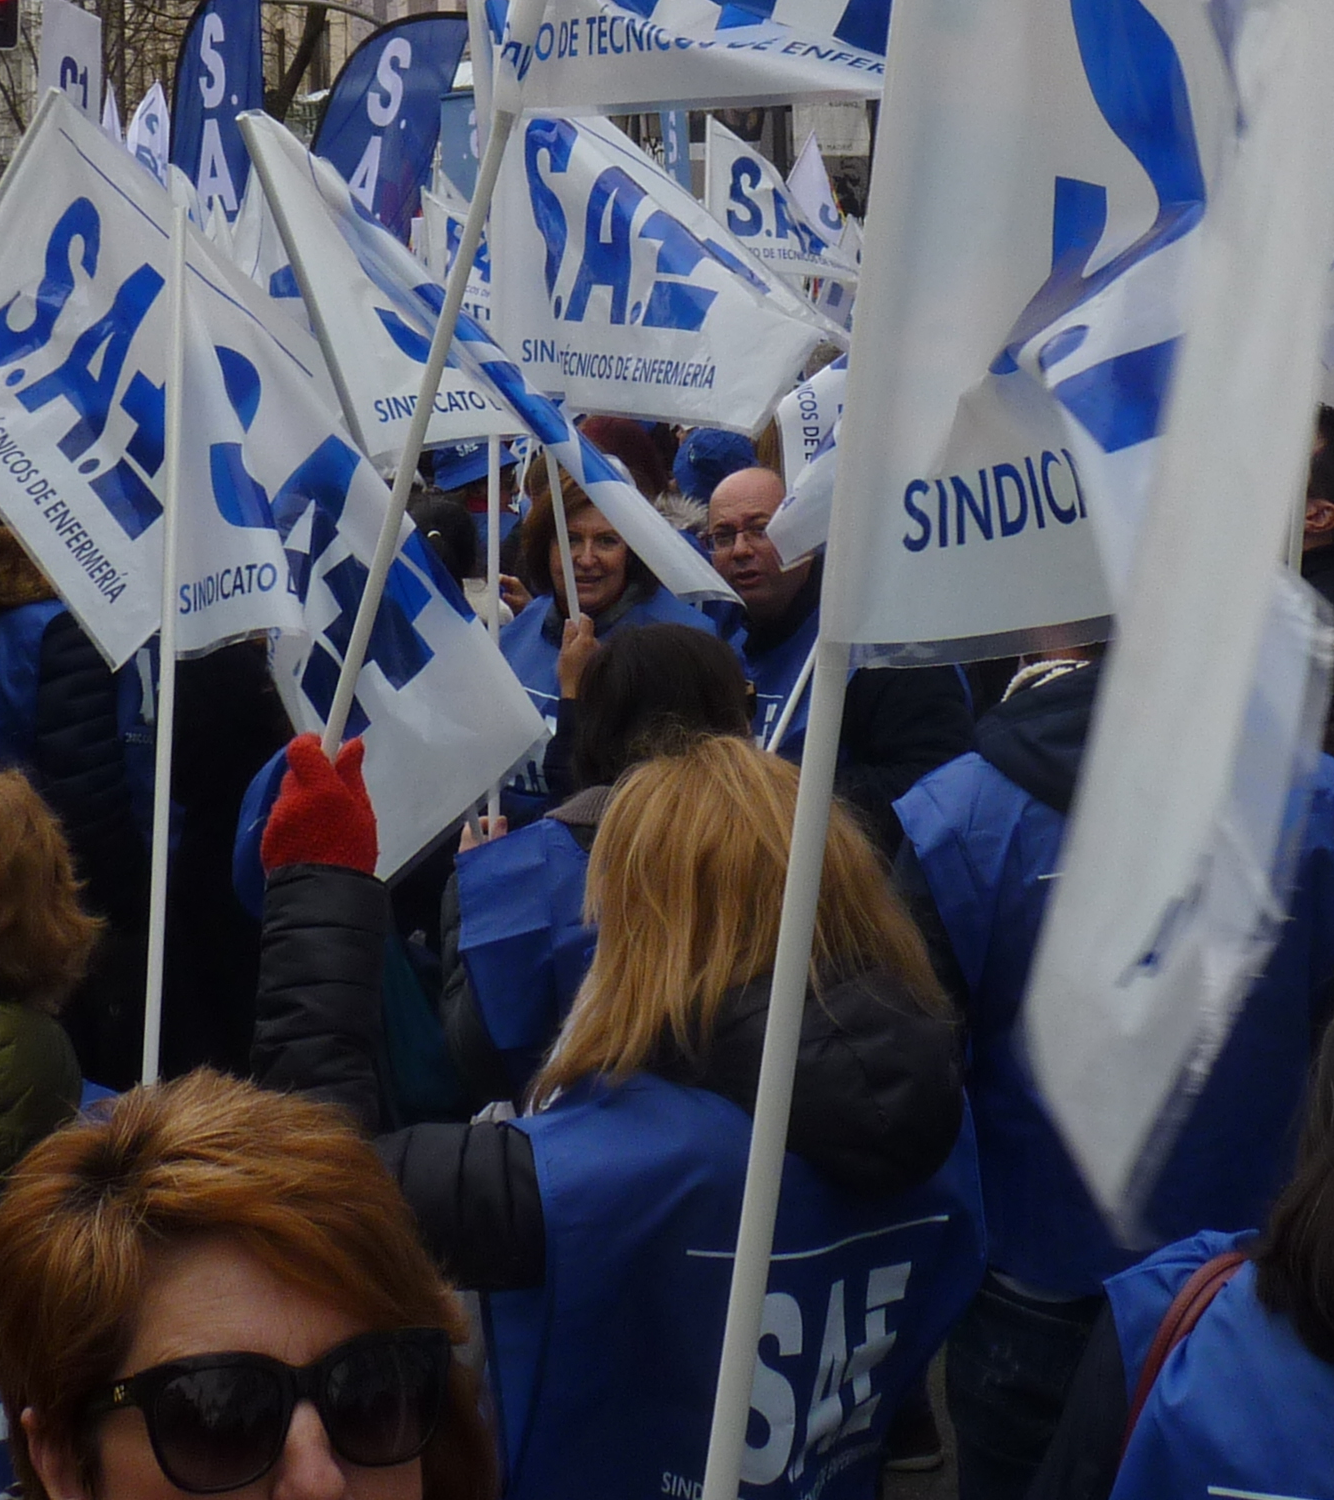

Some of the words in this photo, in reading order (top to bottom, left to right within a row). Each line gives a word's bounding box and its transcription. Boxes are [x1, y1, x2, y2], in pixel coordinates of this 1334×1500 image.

[558, 18, 580, 59] DE
[614, 358, 632, 382] DE
[632, 356, 716, 390] ENFERMERÍA
[374, 390, 486, 424] SINCATO
[803, 426, 820, 447] DE
[901, 447, 1088, 554] SINDIC
[25, 476, 48, 508] DE
[43, 500, 128, 605] ENFERMERÍA
[179, 562, 278, 615] SINDICATO
